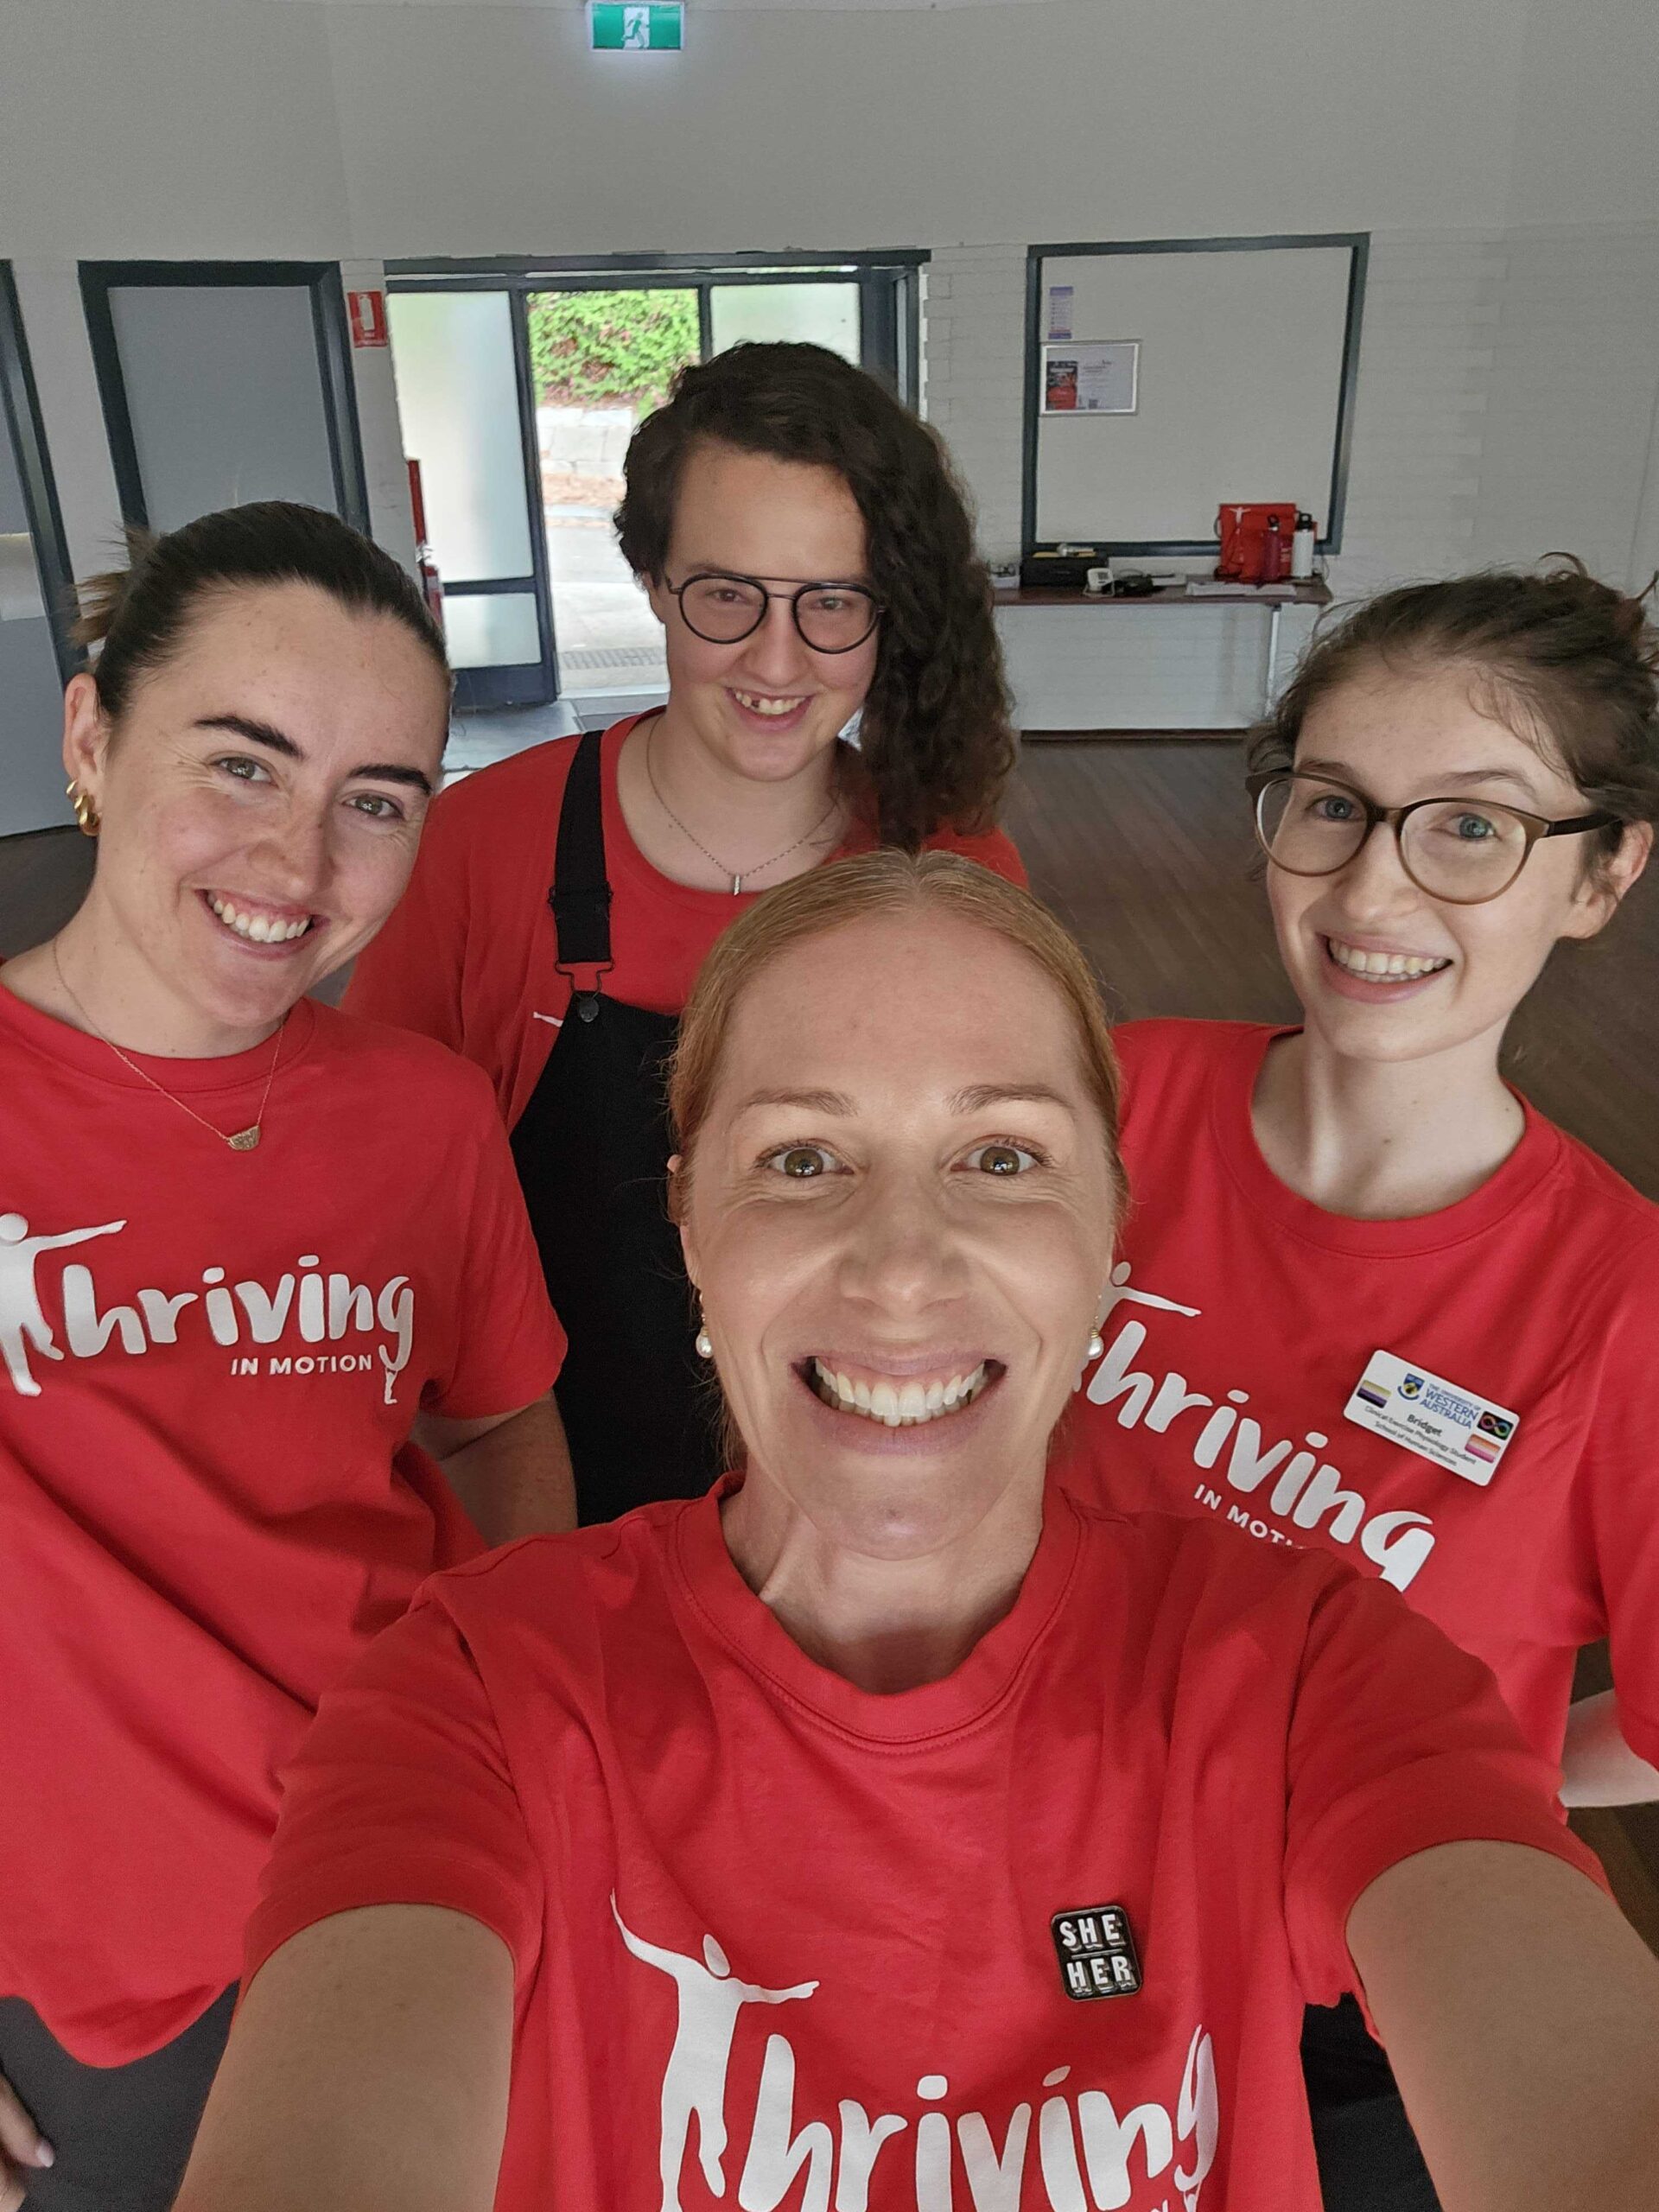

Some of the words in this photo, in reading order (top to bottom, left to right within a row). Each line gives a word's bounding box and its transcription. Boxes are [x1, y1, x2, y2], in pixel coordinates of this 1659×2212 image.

[231, 1357, 258, 1376] IN
[270, 1354, 372, 1376] MOTION
[1419, 1397, 1473, 1429] AUSTRALIA
[1423, 1389, 1479, 1421] WESTERN
[1074, 1262, 1435, 1592] hriving
[1405, 1414, 1443, 1439] Bridget
[1449, 1448, 1477, 1465] Student
[1194, 1484, 1222, 1510] IN
[1227, 1504, 1306, 1549] MOT
[1059, 1913, 1121, 1948] SHE
[1066, 1955, 1132, 1989] HER
[609, 1889, 1219, 2212] Thriving
